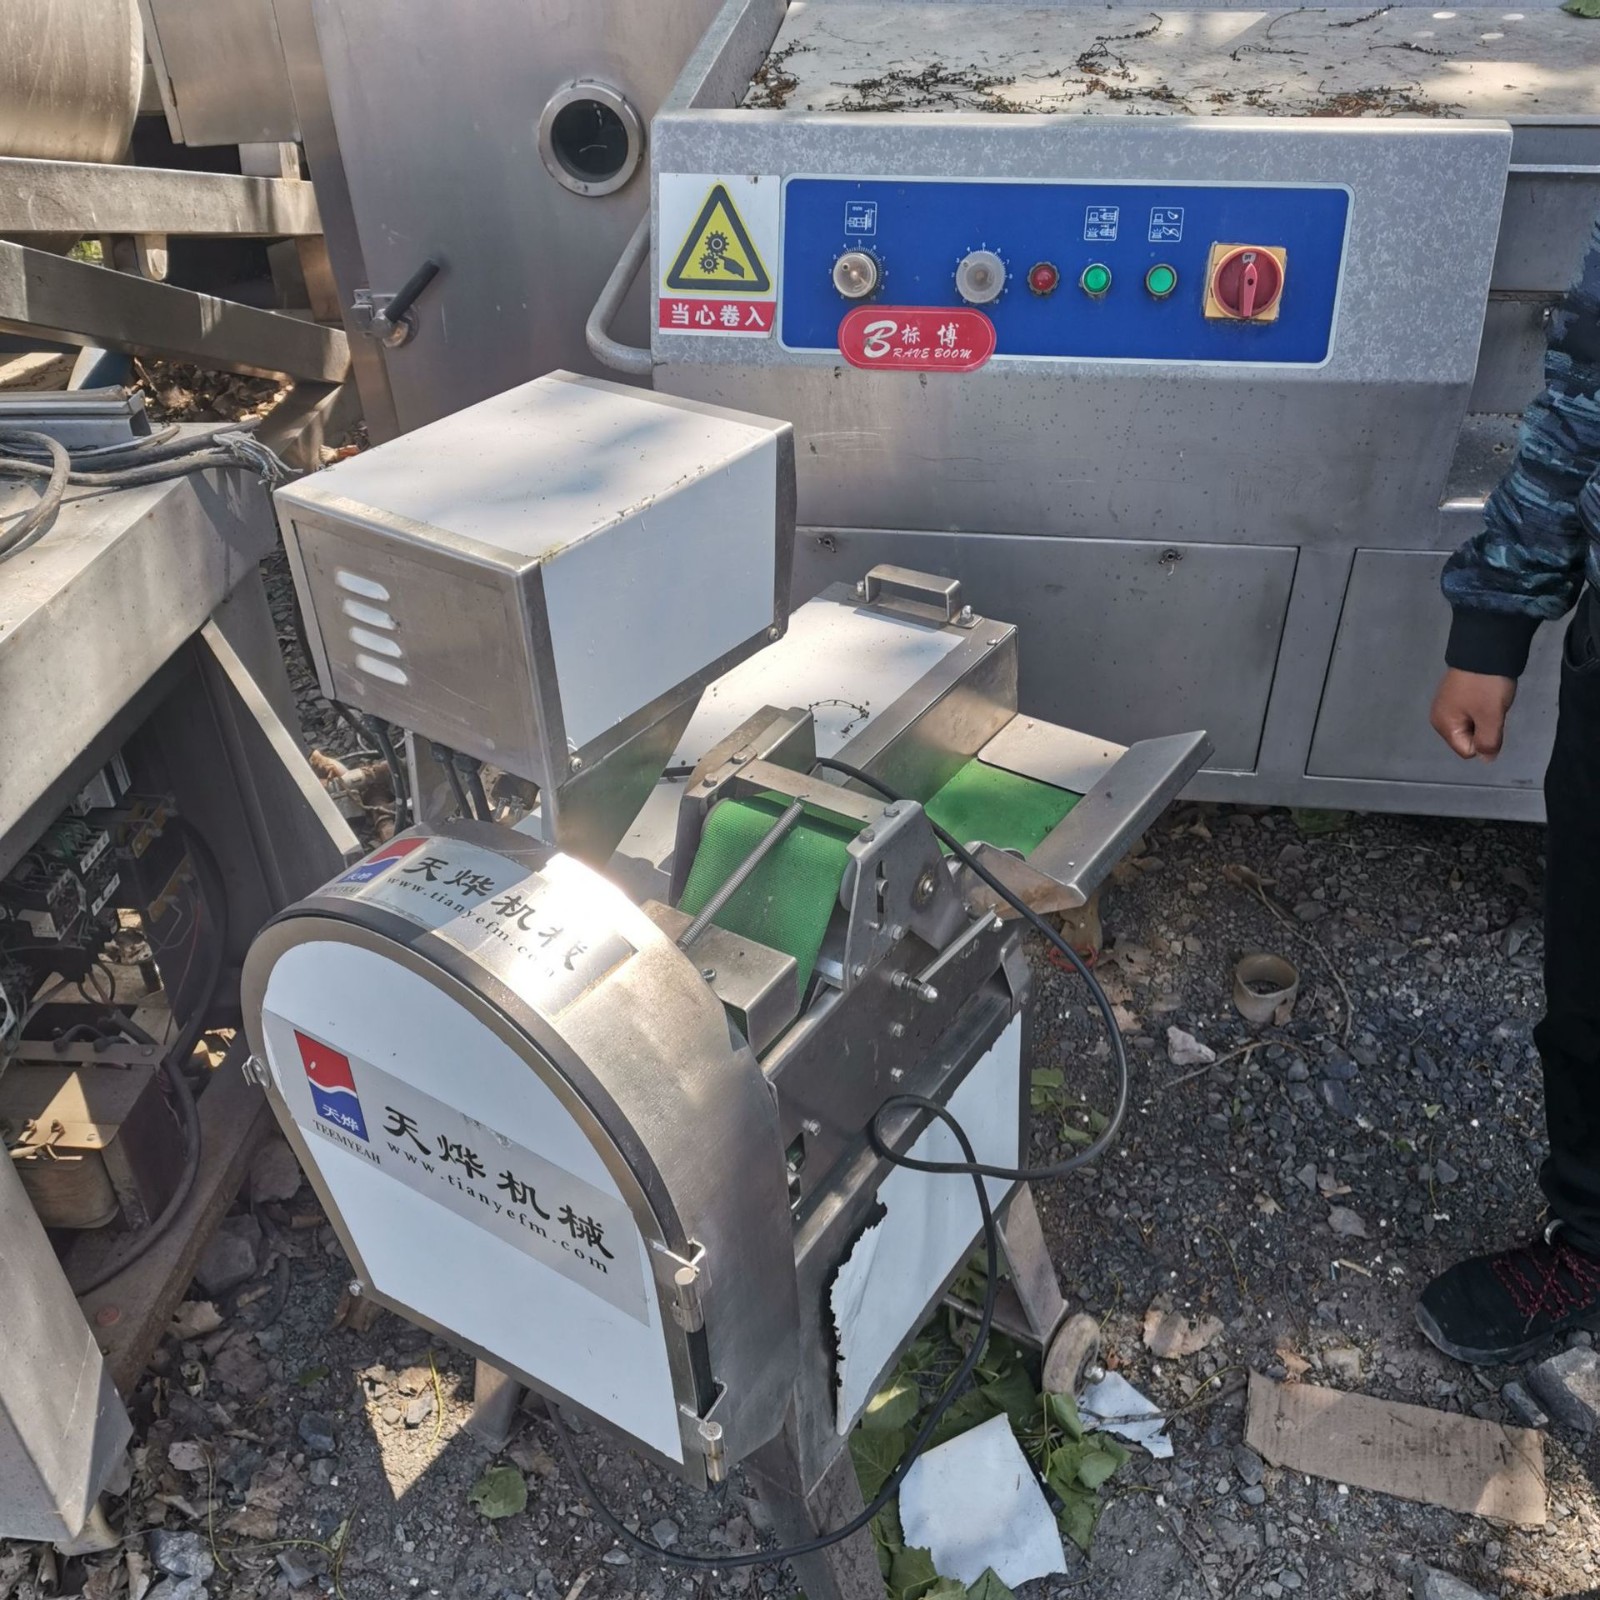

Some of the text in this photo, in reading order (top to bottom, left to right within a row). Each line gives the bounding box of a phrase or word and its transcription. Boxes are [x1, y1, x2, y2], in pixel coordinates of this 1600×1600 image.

[671, 303, 766, 327] 当心卷入
[901, 322, 959, 348] 标博
[934, 348, 972, 359] BOOM
[387, 877, 555, 977] www.tianyefm.co
[322, 1104, 360, 1132] 天烨
[383, 1106, 615, 1260] 天烨机械
[386, 1140, 609, 1274] www.tianyefm.com
